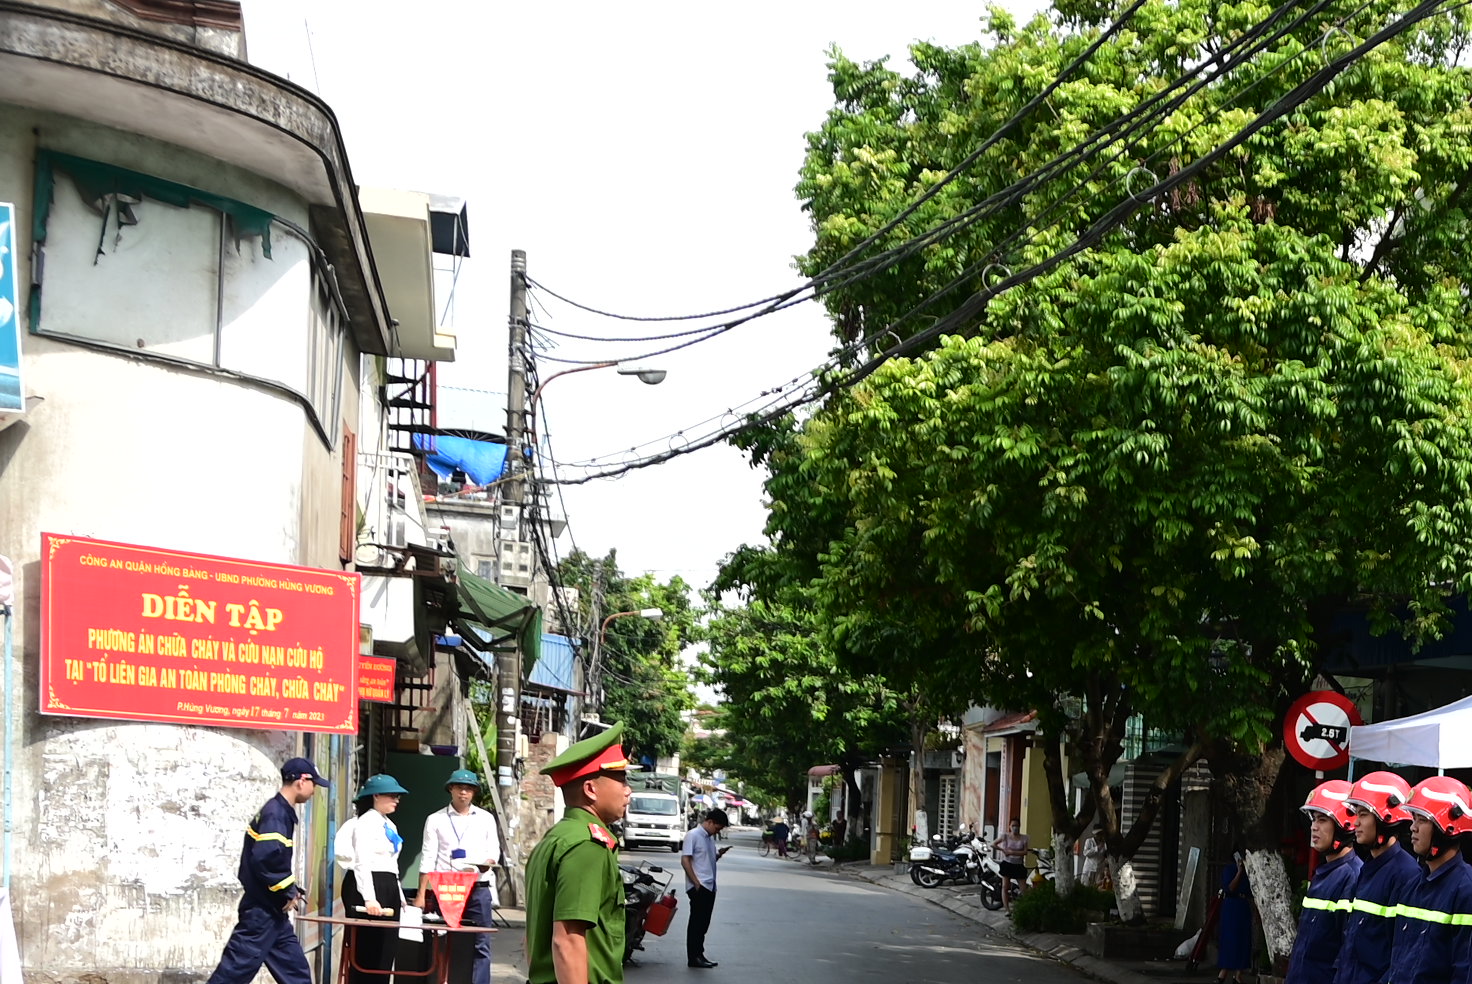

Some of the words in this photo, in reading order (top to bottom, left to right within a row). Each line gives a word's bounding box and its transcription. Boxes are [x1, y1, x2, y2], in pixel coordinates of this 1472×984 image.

[79, 553, 107, 567] CÔNG
[110, 559, 123, 569] AN
[125, 560, 151, 574] QUẬN
[154, 561, 180, 577] HỒNG
[215, 572, 240, 584] UBND
[241, 574, 278, 589] PHƯỜNG
[279, 578, 303, 592] HÙNG
[304, 583, 333, 595] VƯƠNG
[141, 584, 217, 624] DIỄN
[225, 599, 283, 635] TẬP
[88, 628, 135, 653] PHƯƠNG
[138, 628, 154, 654] ÁN
[157, 632, 187, 657] CHỮA
[191, 635, 219, 660] CHÁY
[222, 637, 236, 662] VÀ
[238, 638, 260, 664] CỨU
[261, 645, 284, 669] NẠN
[287, 642, 307, 668] CỨU
[310, 646, 323, 674] HỘ
[65, 659, 83, 685] TẠI
[86, 653, 108, 683] "TỔ
[110, 659, 135, 685] LIÊN
[138, 665, 157, 687] GIA
[160, 668, 176, 689] AN
[179, 665, 208, 692] TOÀN
[210, 668, 246, 694] PHÒNG
[250, 672, 279, 699] CHÁY,
[282, 675, 309, 699] CHỮA
[177, 702, 203, 715] P.Hùng
[232, 706, 250, 718] ngày
[251, 706, 260, 716] 17
[261, 708, 281, 719] tháng
[283, 708, 289, 718] 7
[309, 711, 325, 721] 2023
